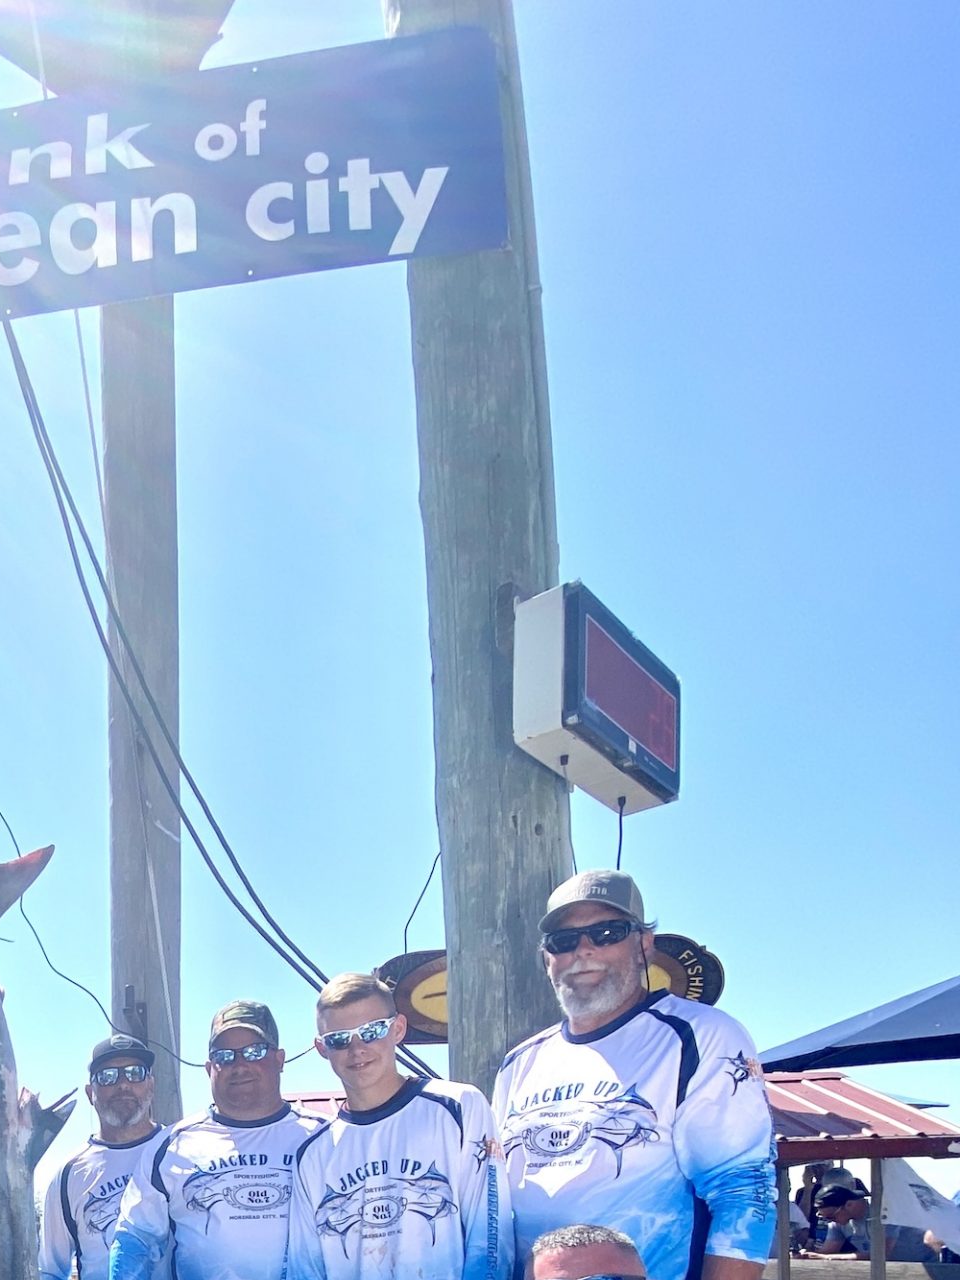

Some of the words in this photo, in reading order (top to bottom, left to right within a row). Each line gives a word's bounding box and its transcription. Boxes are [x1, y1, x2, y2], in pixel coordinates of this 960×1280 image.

[194, 100, 267, 162] of
[246, 152, 450, 256] city
[678, 949, 704, 1002] FISHIN
[520, 1082, 585, 1110] JACKED
[593, 1080, 620, 1097] UP
[550, 1130, 570, 1140] Old
[208, 1154, 268, 1172] JACKED
[400, 1159, 422, 1176] UP
[373, 1204, 390, 1213] Old
